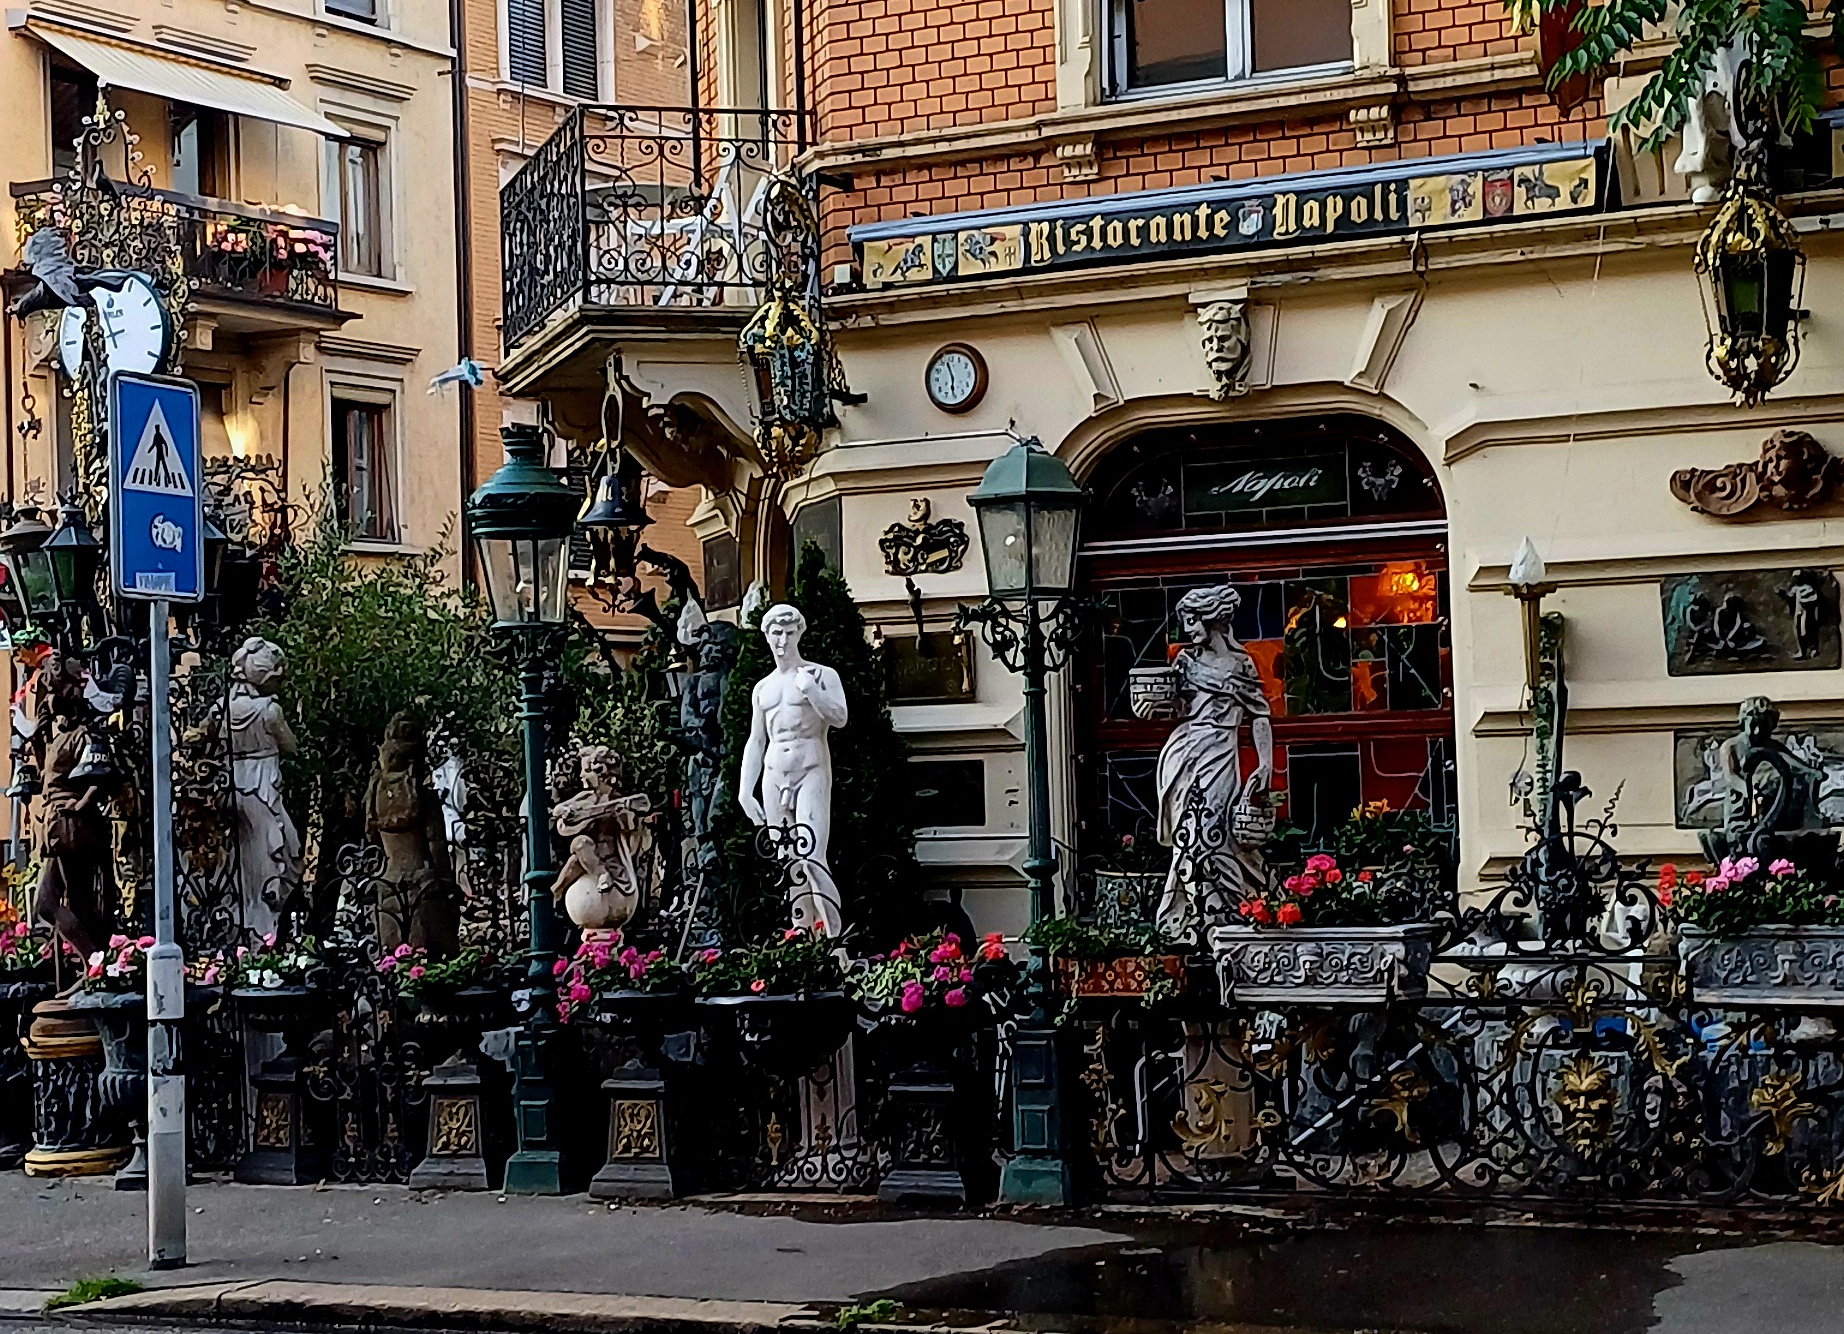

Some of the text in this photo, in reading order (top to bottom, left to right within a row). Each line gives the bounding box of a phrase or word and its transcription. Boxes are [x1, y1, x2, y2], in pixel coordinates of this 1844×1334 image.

[1028, 182, 1402, 267] Ristorante Napoli
[1208, 467, 1323, 502] Napoli
